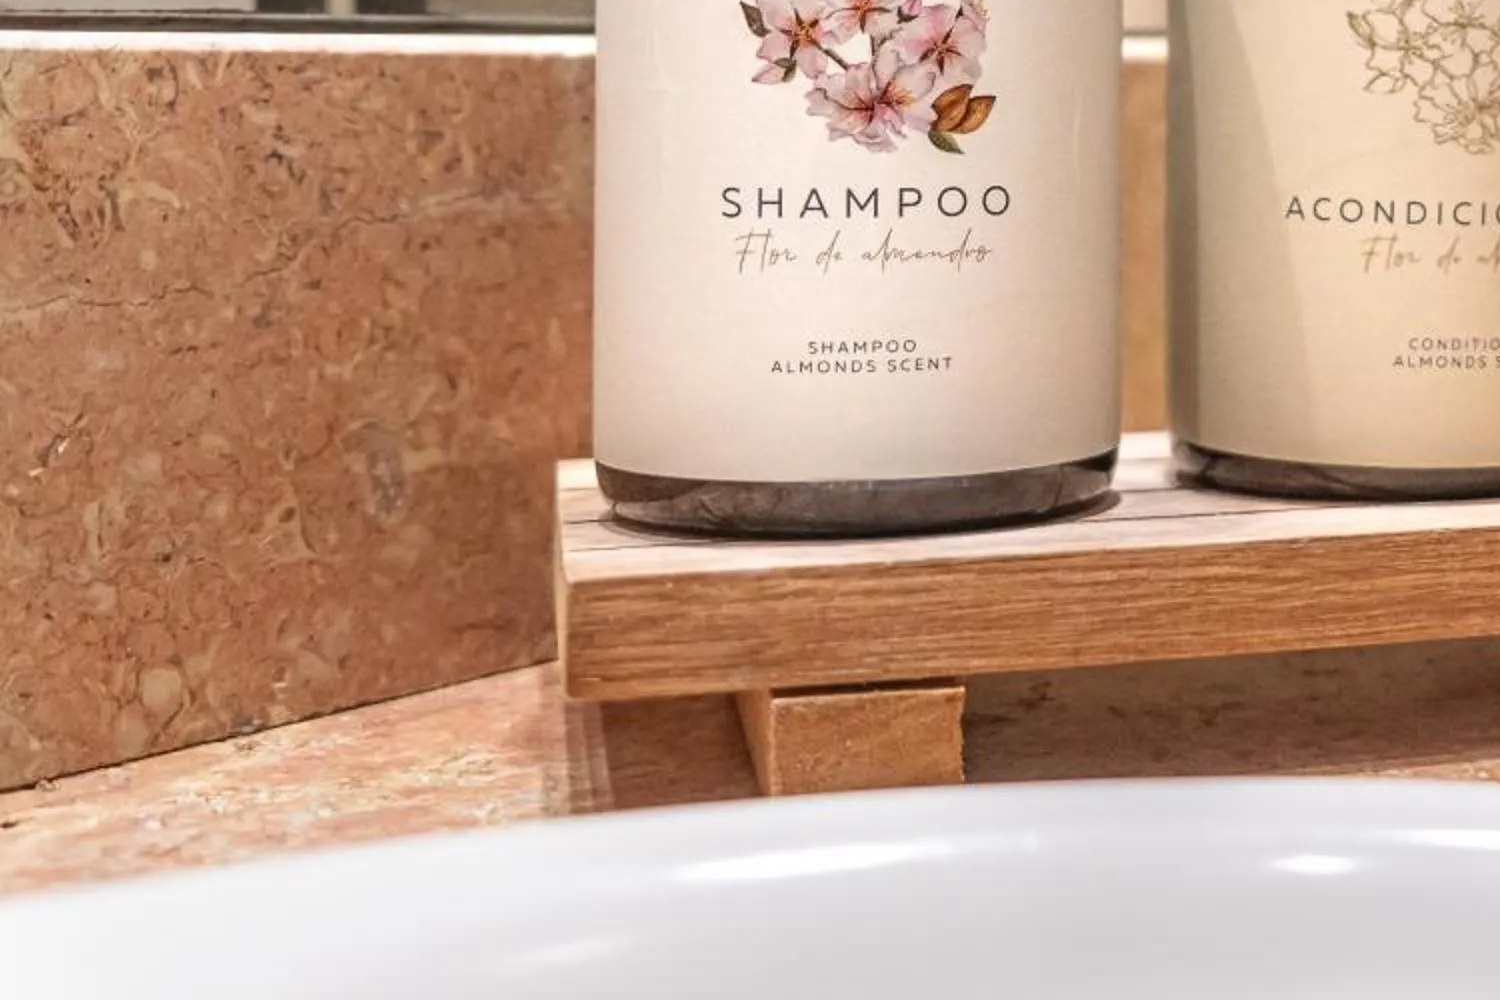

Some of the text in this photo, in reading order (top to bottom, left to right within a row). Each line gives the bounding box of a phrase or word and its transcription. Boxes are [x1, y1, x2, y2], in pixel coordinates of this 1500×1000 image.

[721, 185, 1011, 219] SHAMPOO
[733, 227, 798, 274] Flor
[815, 229, 843, 274] de
[807, 338, 918, 355] SHAMPOO
[771, 356, 954, 374] ALMONDS SCENT
[1392, 354, 1487, 370] ALMONDS
